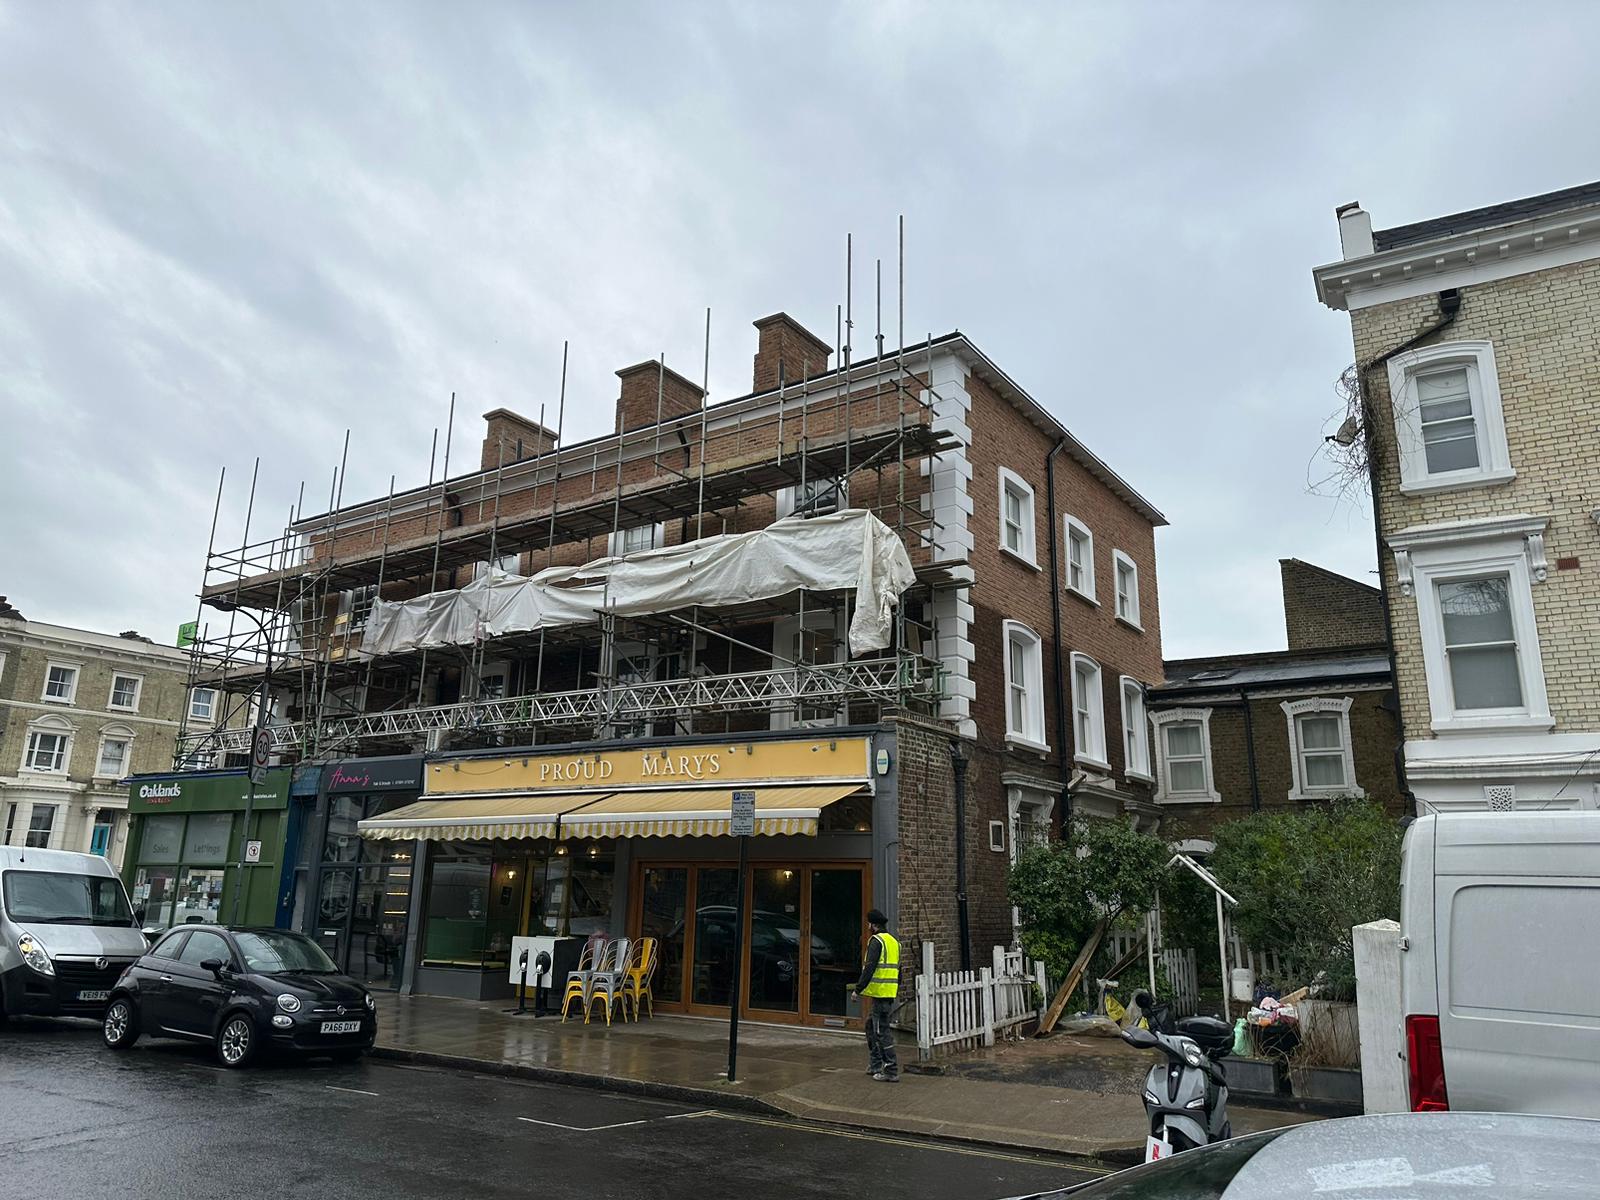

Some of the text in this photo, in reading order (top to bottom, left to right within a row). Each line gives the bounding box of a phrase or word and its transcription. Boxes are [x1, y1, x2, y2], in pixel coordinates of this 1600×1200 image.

[257, 740, 268, 755] 30
[540, 754, 720, 781] PROUD MARY'S
[139, 782, 181, 798] Oaklands
[152, 843, 220, 856] Sales Lettings
